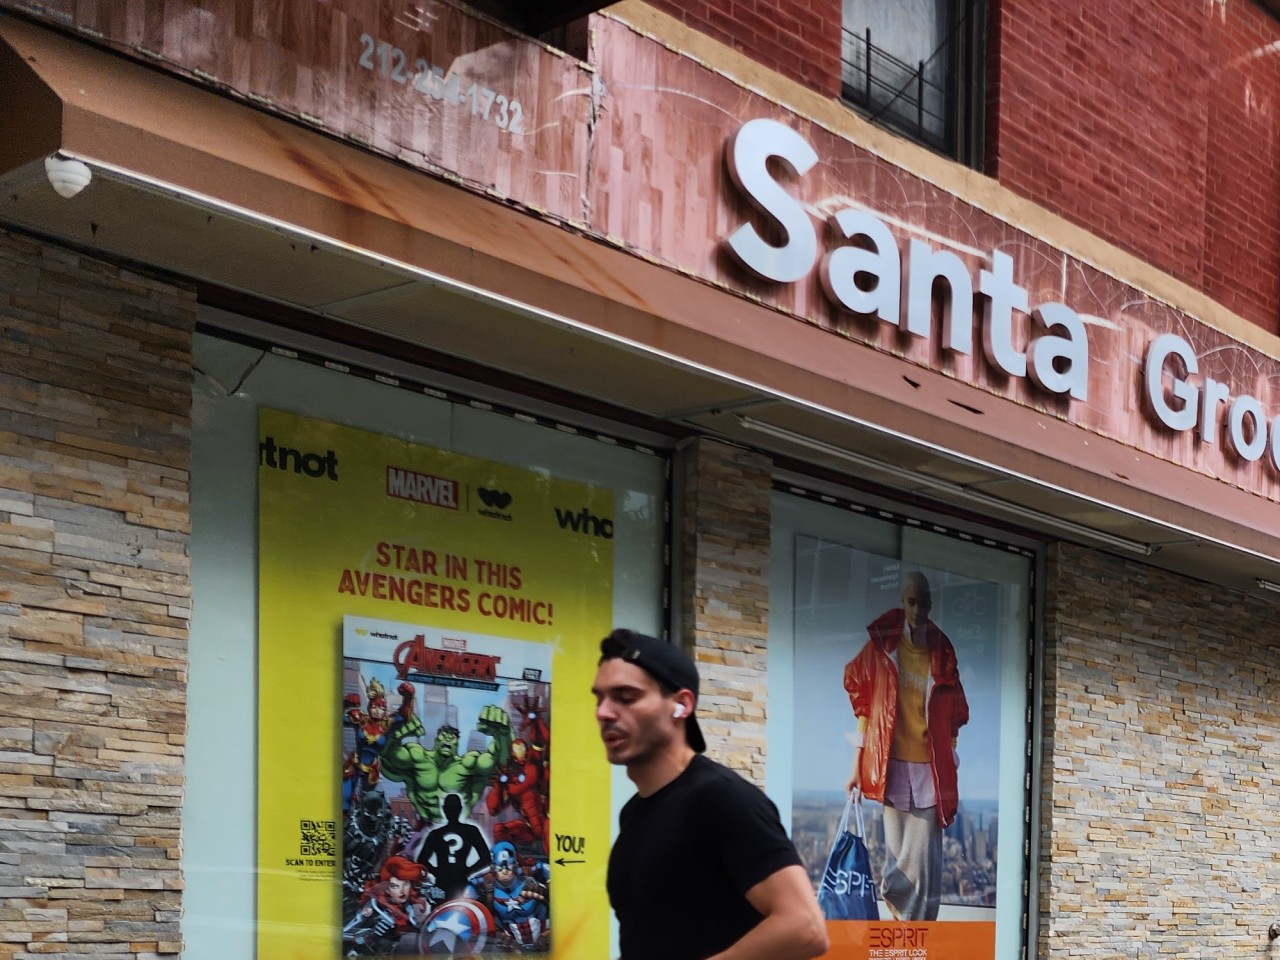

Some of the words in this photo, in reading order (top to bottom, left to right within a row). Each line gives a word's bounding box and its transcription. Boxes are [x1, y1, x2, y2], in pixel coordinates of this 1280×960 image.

[359, 32, 523, 134] 212-254-1732
[725, 118, 1088, 401] Santa
[387, 467, 458, 509] MARVEL
[376, 542, 438, 576] STAR
[445, 553, 467, 580] IN
[474, 559, 523, 590] THIS
[338, 569, 471, 613] AVENGERS
[477, 592, 554, 626] COMIC!
[315, 859, 336, 867] ENTER
[555, 834, 585, 855] YOU!
[869, 928, 929, 948] ESPRIT
[869, 949, 884, 957] THE
[884, 949, 908, 957] ESPRIT
[908, 949, 928, 957] LOOK
